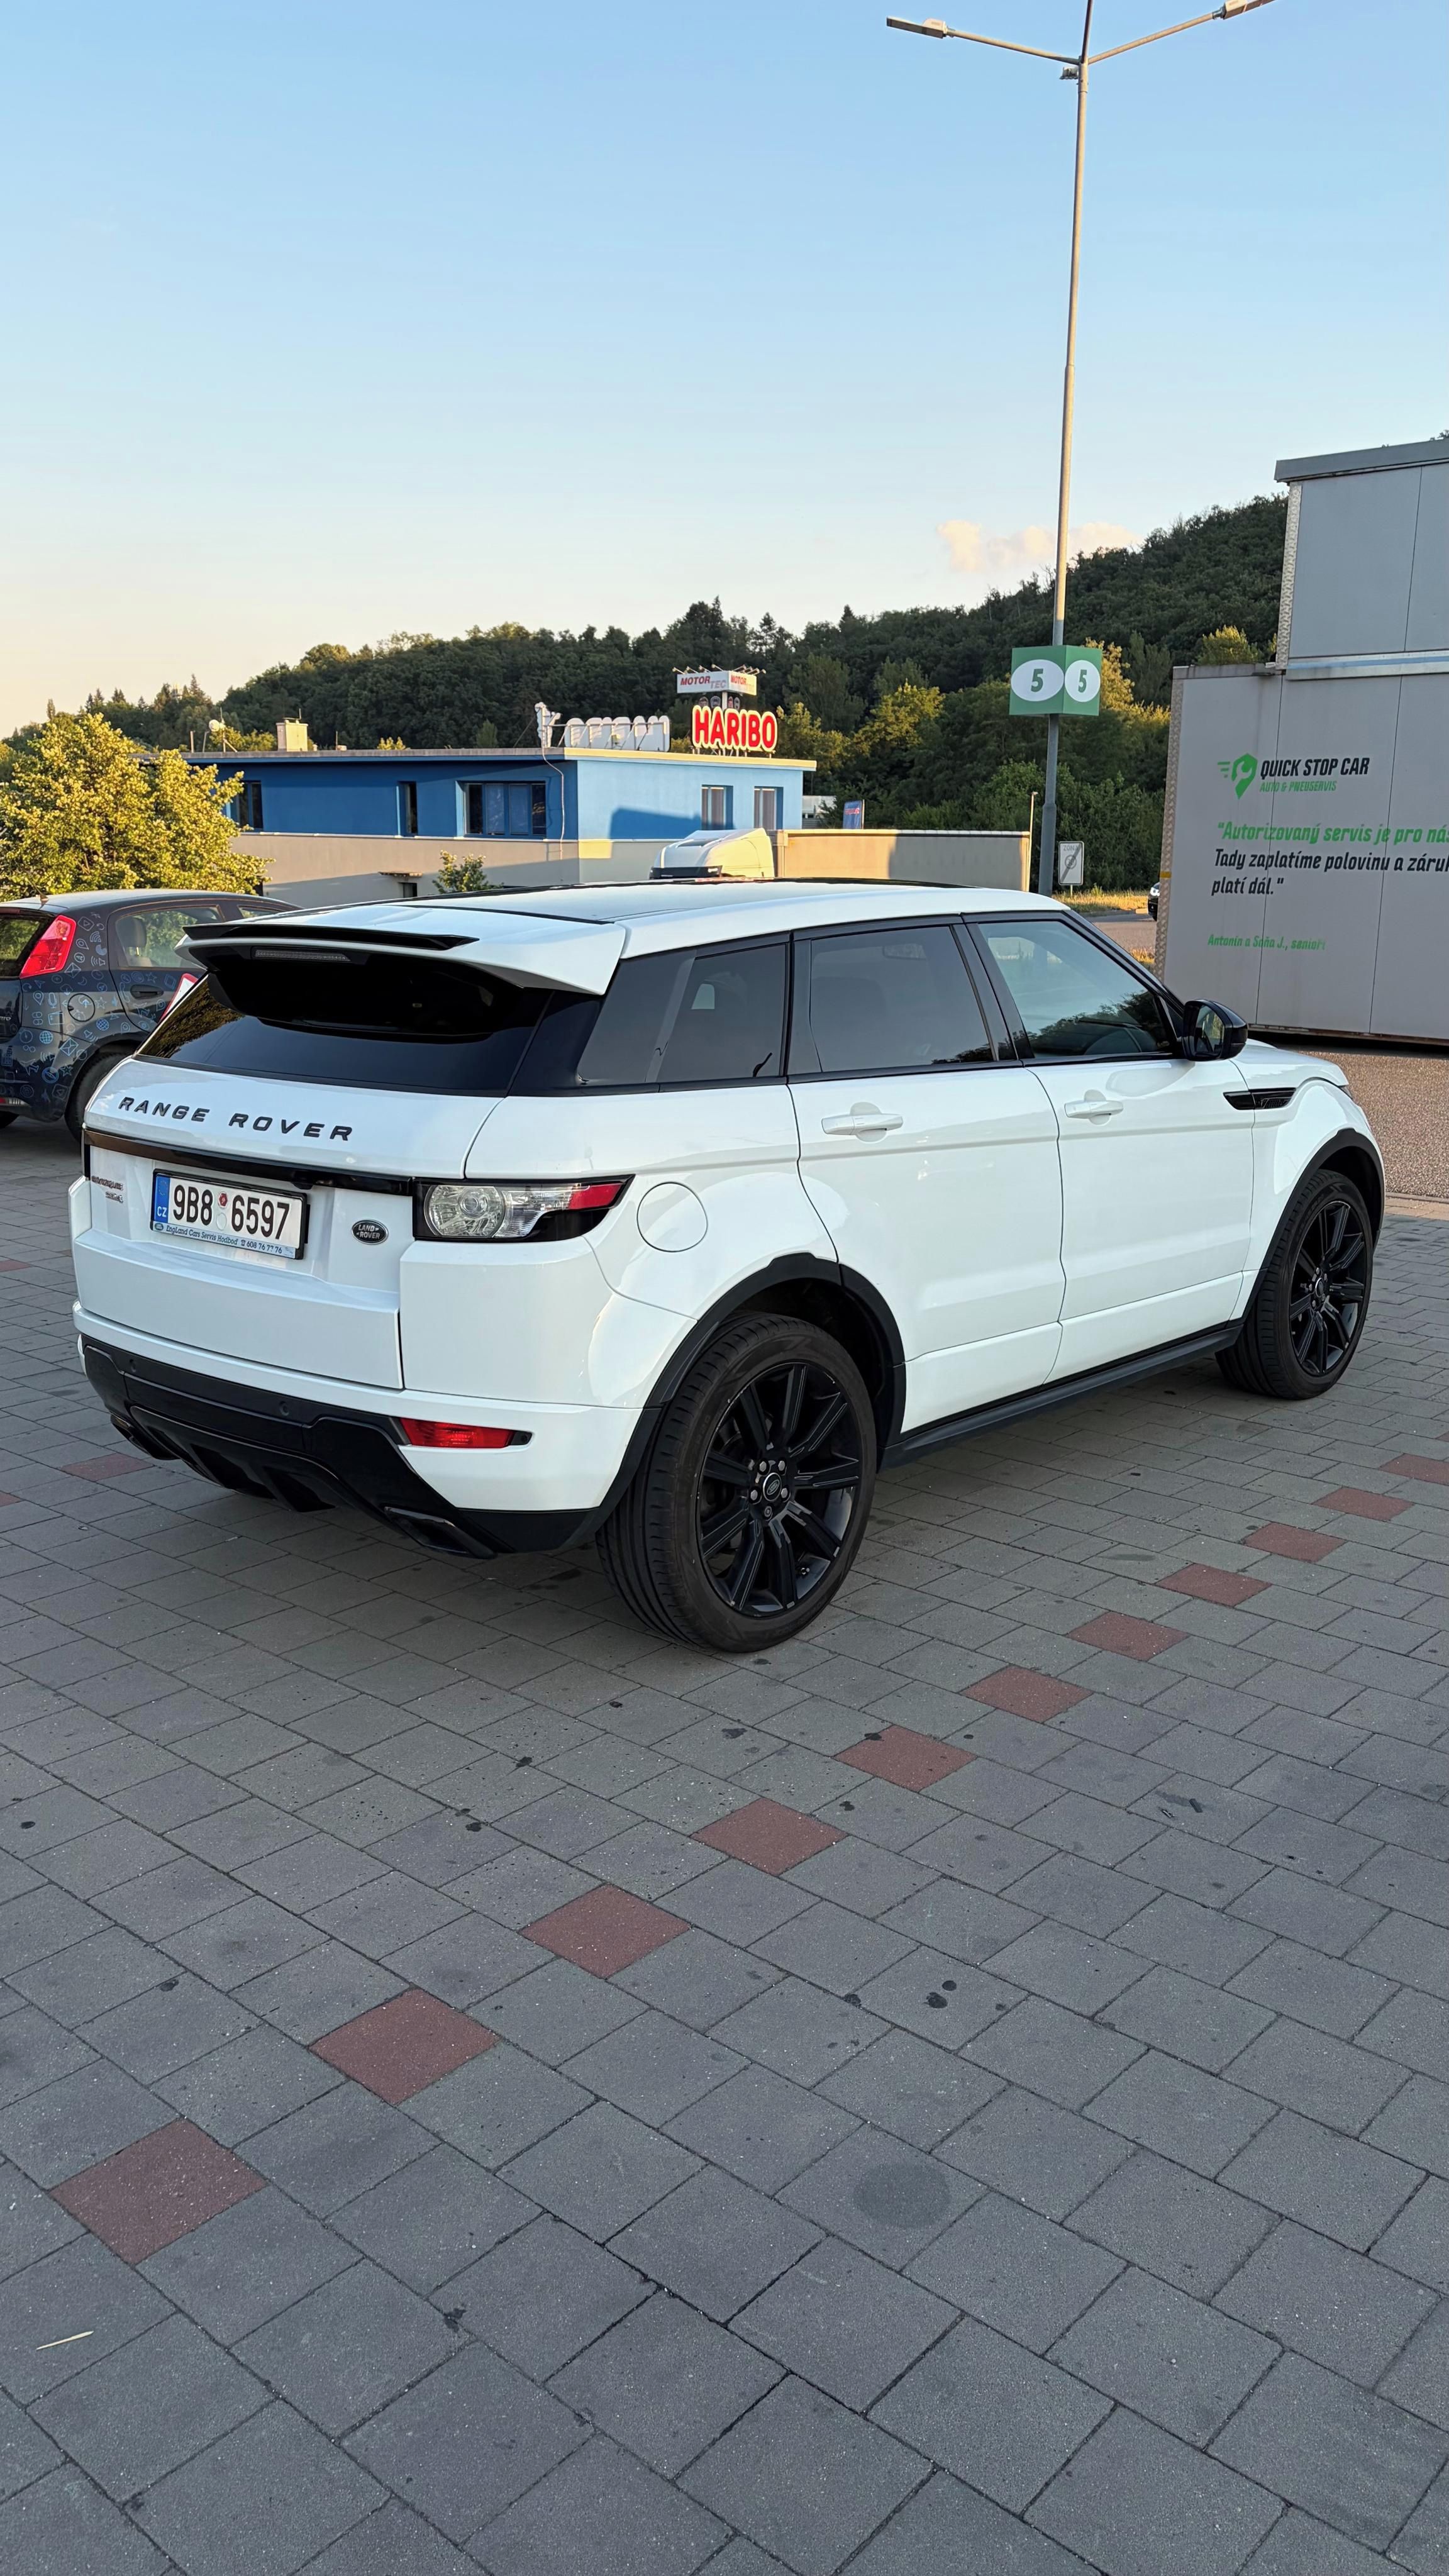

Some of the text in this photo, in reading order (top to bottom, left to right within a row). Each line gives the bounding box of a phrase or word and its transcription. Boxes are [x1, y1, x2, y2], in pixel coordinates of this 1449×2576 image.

[680, 675, 711, 686] MOTOR
[710, 680, 726, 689] TEC
[731, 675, 747, 684] MOTOR
[1031, 669, 1043, 692] 5
[1078, 669, 1087, 692] 5
[693, 707, 777, 750] HARIBO
[1260, 757, 1370, 780] QUICK STOP CAR
[1260, 780, 1337, 792] AUTO & PNEUSERVIS
[1323, 824, 1372, 842] servis
[1374, 824, 1391, 845] je
[1394, 828, 1423, 845] pro
[1426, 824, 1449, 843] ná
[1215, 848, 1246, 870] Tady
[1248, 850, 1321, 870] zaplatíme
[1324, 852, 1391, 872] polovinu
[1394, 857, 1404, 871] a
[1211, 877, 1247, 896] platí
[1208, 934, 1243, 947] Antonín
[1245, 938, 1250, 947] a
[1253, 935, 1275, 948] Soňa
[118, 1096, 353, 1141] RANGE ROVER
[157, 1206, 167, 1218] CZ
[173, 1185, 290, 1240] 9B8 6597
[358, 1224, 375, 1232] LAND
[359, 1231, 380, 1239] ROVER
[189, 1229, 200, 1238] Cars
[201, 1231, 216, 1240] Servis
[247, 1241, 257, 1249] 608
